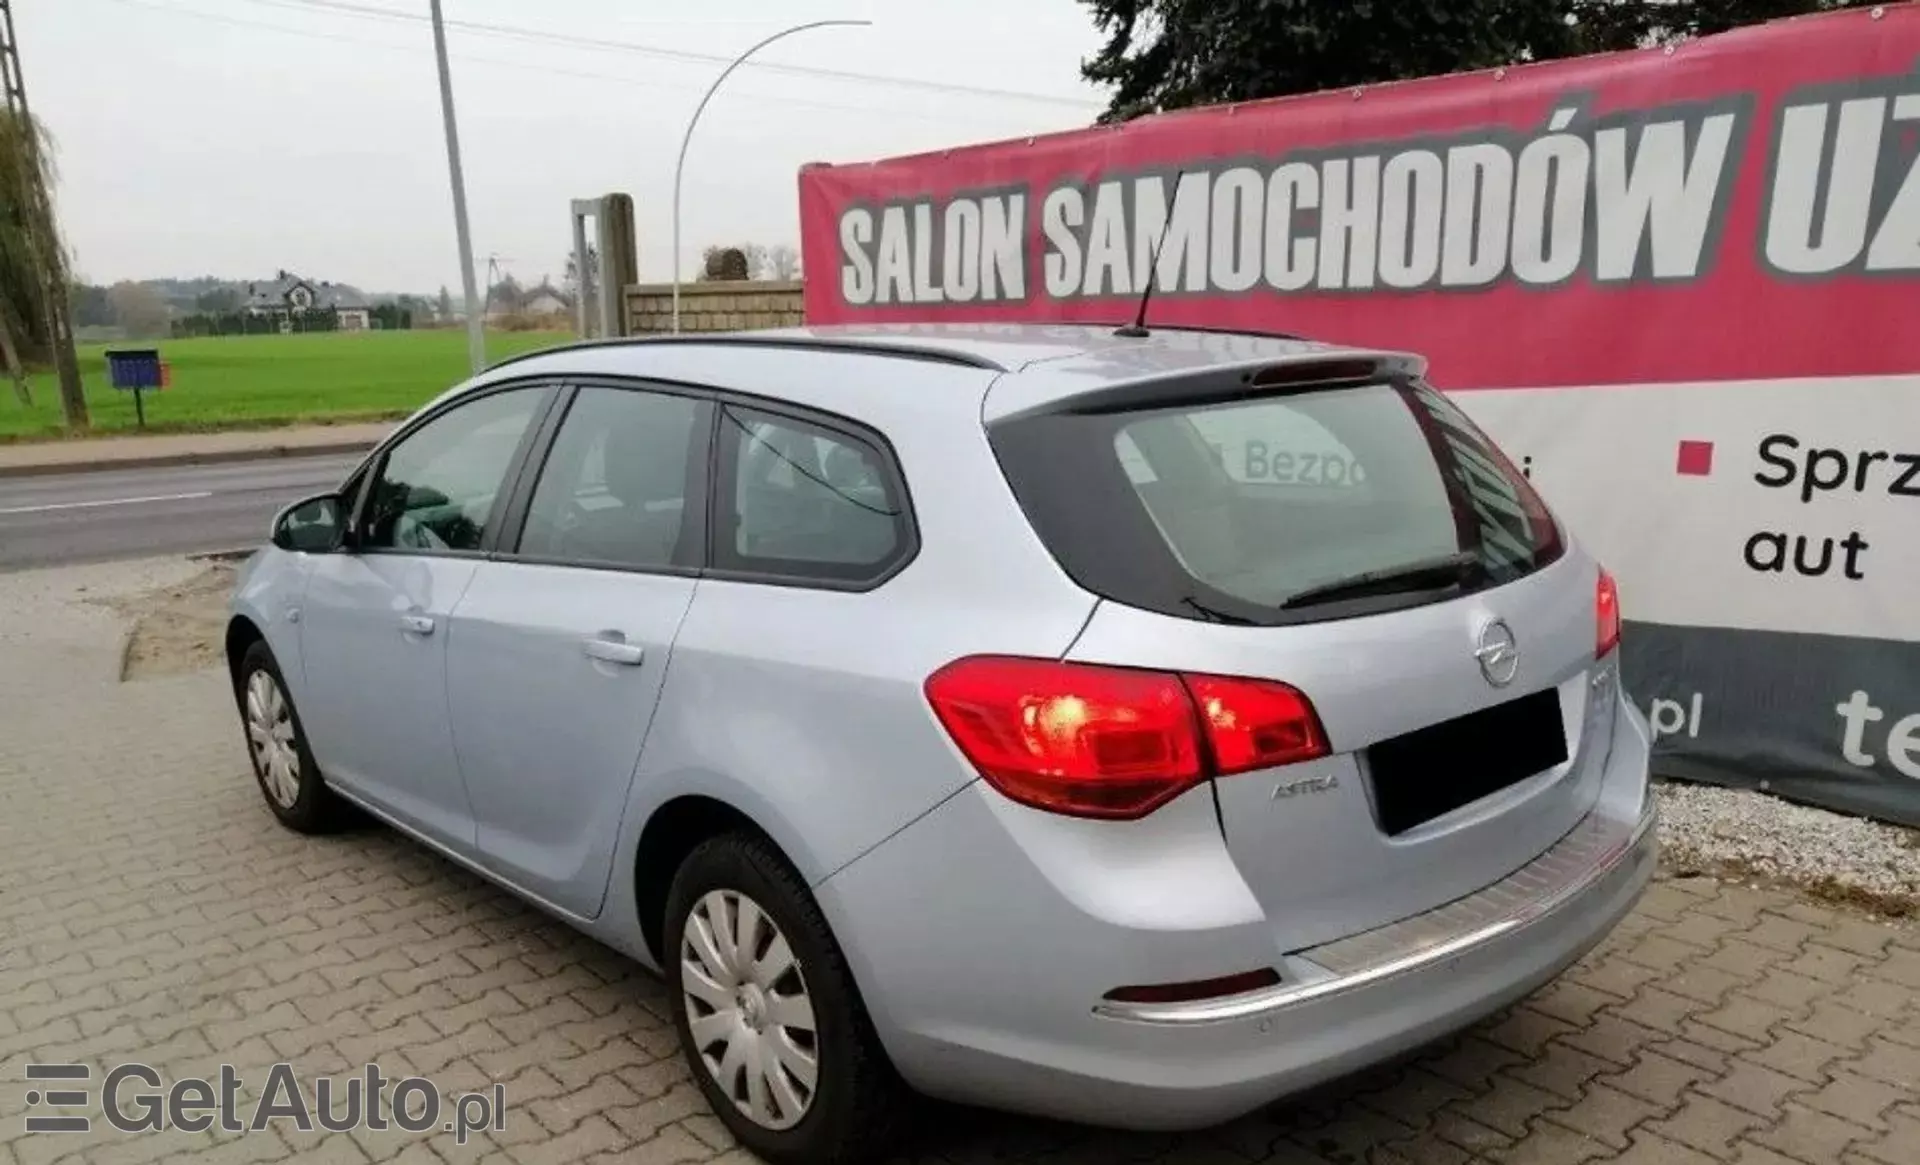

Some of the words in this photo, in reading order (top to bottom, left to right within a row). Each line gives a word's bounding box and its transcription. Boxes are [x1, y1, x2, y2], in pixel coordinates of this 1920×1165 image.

[841, 193, 1026, 304] SALON
[1044, 107, 1736, 297] SAMOCHODÓW
[1754, 433, 1920, 503] Sprz
[1743, 531, 1870, 580] aut
